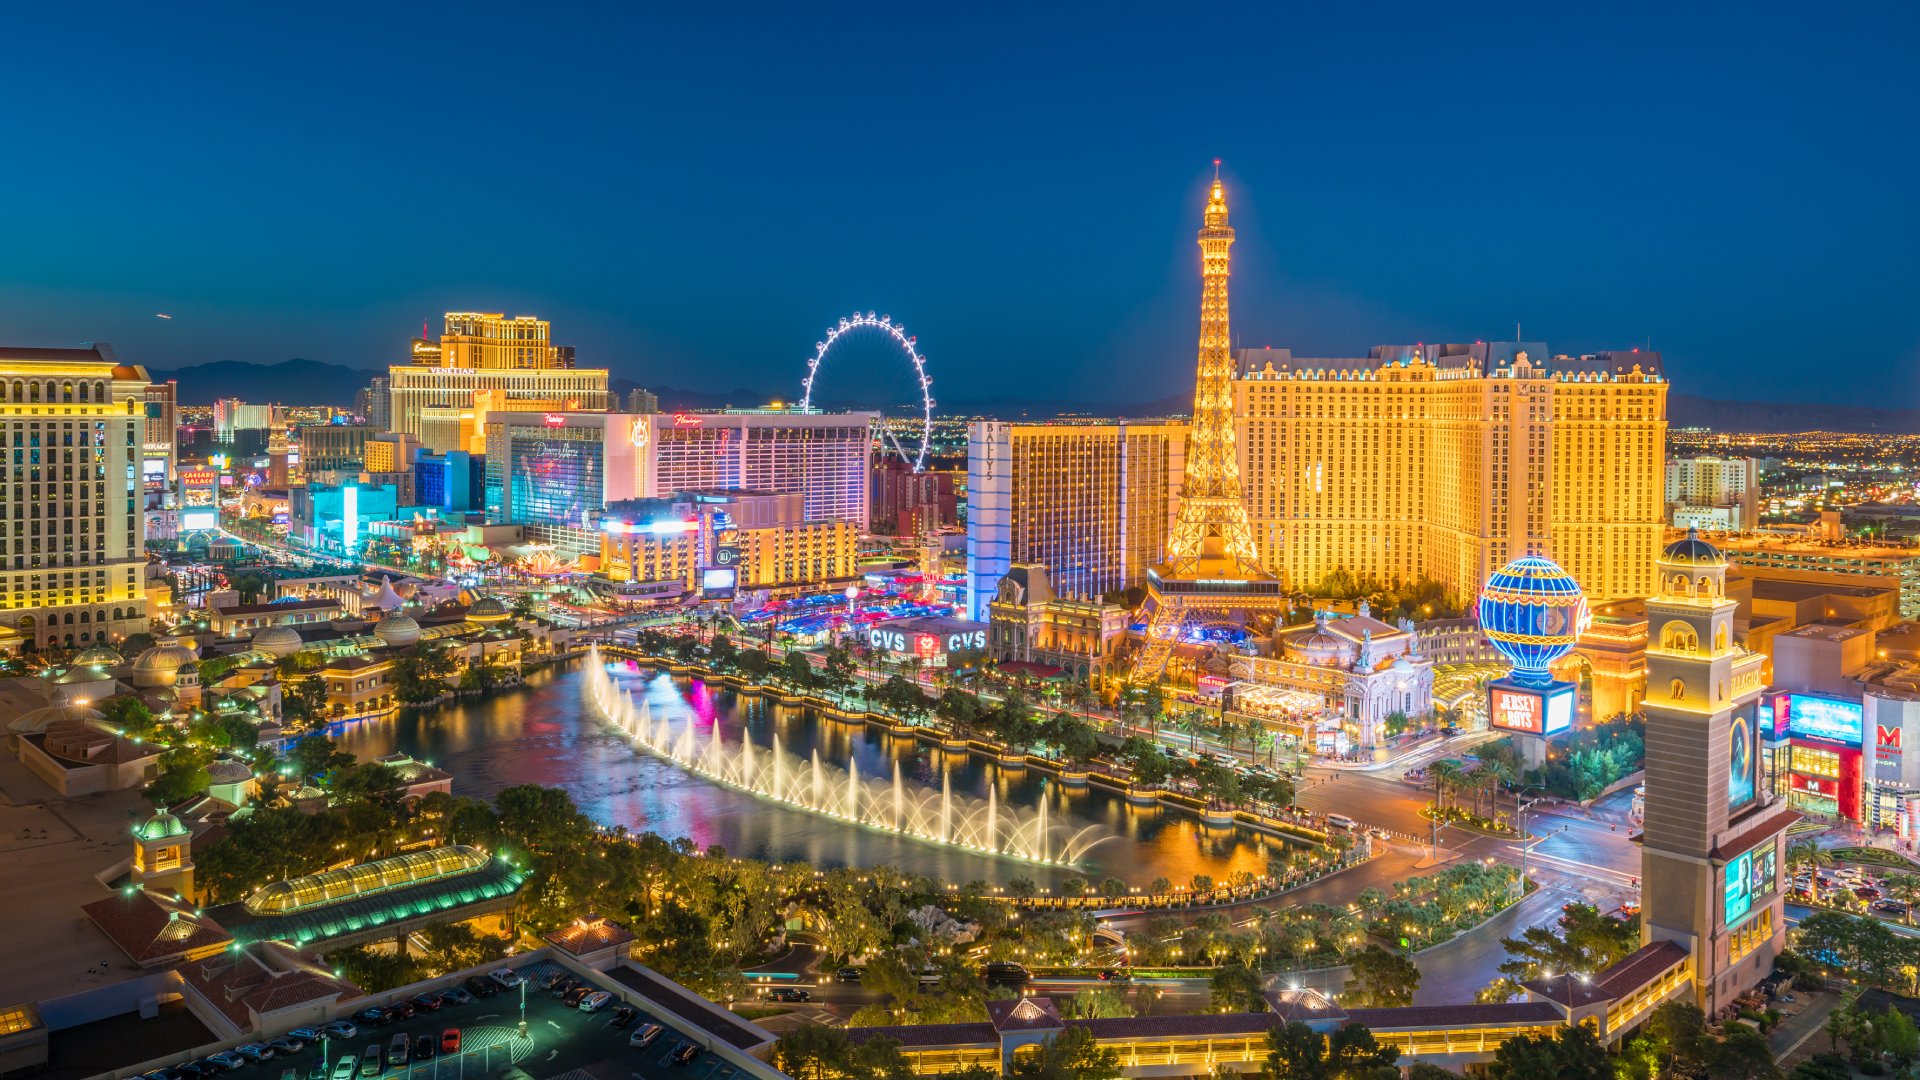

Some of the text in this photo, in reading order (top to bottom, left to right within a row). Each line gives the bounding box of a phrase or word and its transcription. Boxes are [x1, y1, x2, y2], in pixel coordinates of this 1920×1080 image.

[430, 367, 475, 375] VENETIAN
[673, 414, 703, 426] Flamingo
[870, 629, 905, 652] CVS
[948, 630, 986, 653] CVS
[1500, 694, 1535, 713] JERSEY
[1507, 710, 1533, 728] BOYS
[1877, 724, 1902, 748] M
[1807, 780, 1819, 791] M
[1868, 776, 1911, 788] SEPHORA
